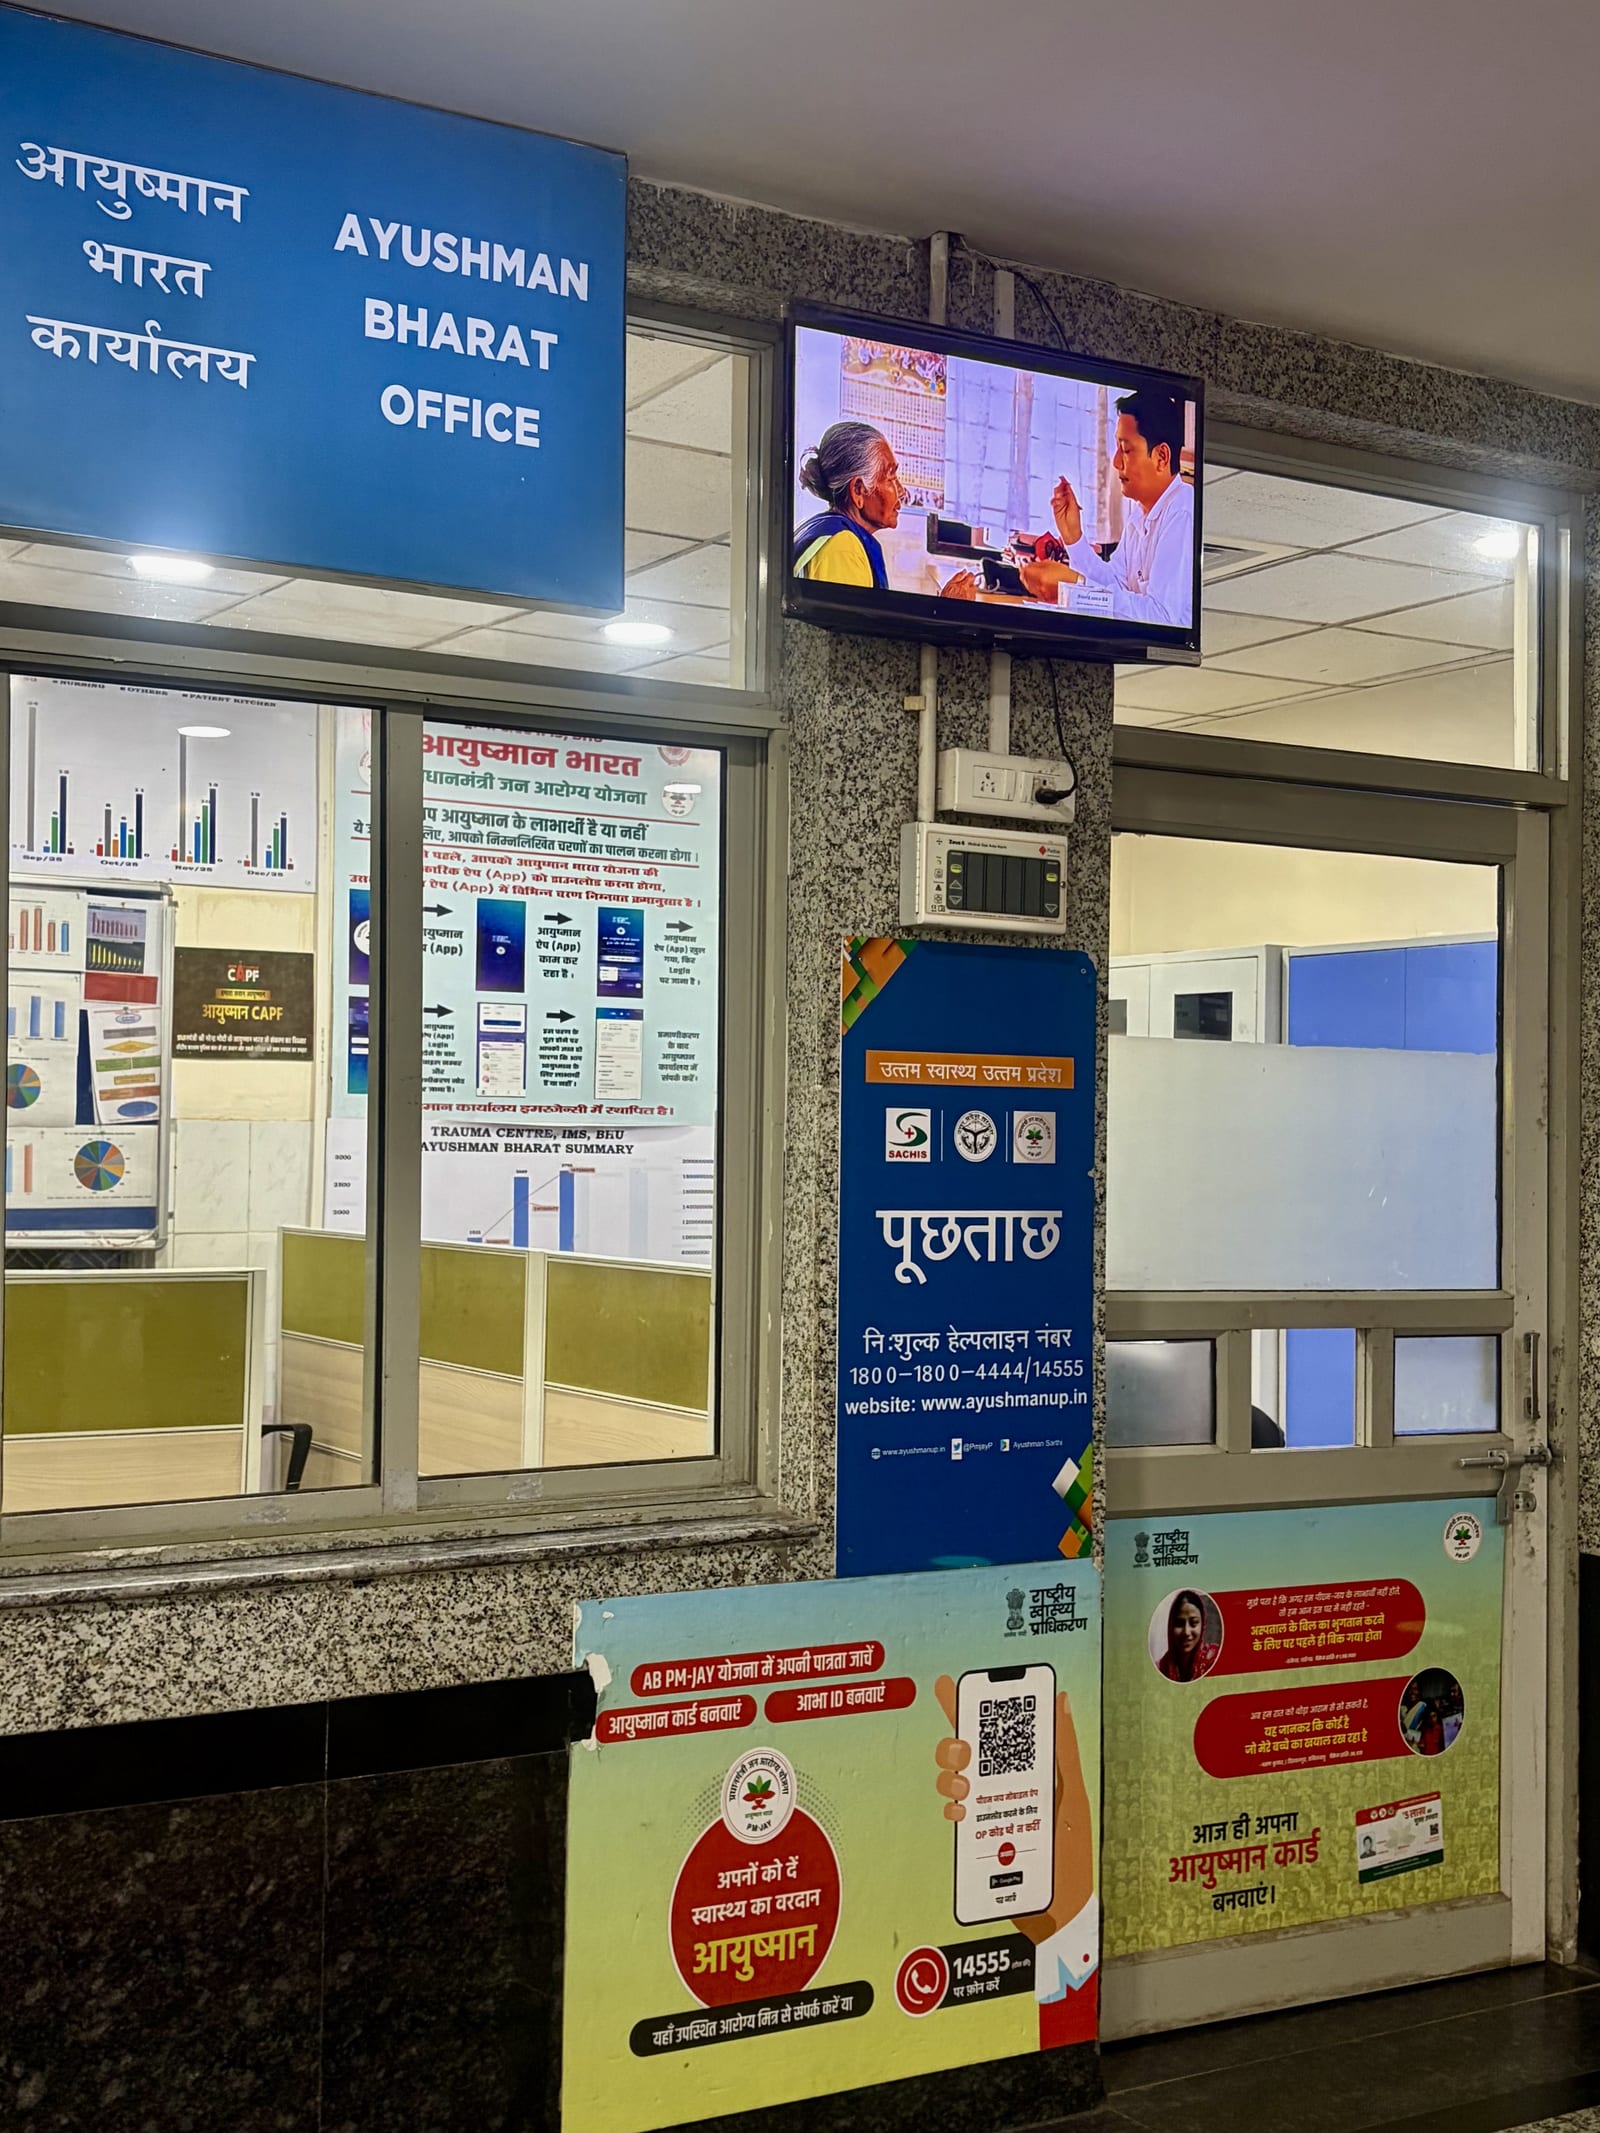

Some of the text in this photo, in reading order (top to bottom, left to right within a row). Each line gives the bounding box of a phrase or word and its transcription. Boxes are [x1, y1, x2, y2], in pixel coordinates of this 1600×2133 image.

[16, 142, 250, 223] आयुष्मान
[334, 213, 589, 301] AYUSHMAN
[83, 239, 212, 298] भारत
[364, 297, 558, 370] BHARAT
[25, 315, 256, 389] कार्यालय
[380, 384, 540, 448] OFFICE
[565, 750, 642, 777] भारत
[498, 777, 530, 793] जन
[534, 780, 590, 799] आरोग्य
[593, 784, 647, 805] योजना
[441, 809, 649, 840] आयुष्मान के लाभार्थी है या नहीं
[448, 830, 484, 844] आपको
[486, 831, 555, 850] निम्नलिखित
[557, 840, 588, 853] चरणों
[589, 843, 603, 854] का
[605, 844, 636, 857] पालन
[638, 849, 667, 860] करना
[486, 869, 527, 881] (App)
[453, 881, 494, 894] (App)
[537, 927, 582, 938] आयुष्मान
[430, 943, 463, 956] (App)
[551, 941, 581, 953] (App)
[538, 954, 578, 965] काम कर
[228, 966, 260, 982] CAPF
[202, 1004, 284, 1024] आयुष्मान CAPF
[879, 1062, 1063, 1083] उत्तम स्वास्थ्य उत्तम प्रदेश
[456, 1101, 603, 1114] कार्यालय में
[431, 1126, 624, 1141] TRAUMA CENTRE, IMS, BHU
[422, 1141, 635, 1155] AYUSHMAN BHARAT SUMMARY
[888, 1149, 927, 1159] SACHIS
[875, 1210, 1063, 1284] पूछताछ
[947, 1325, 1029, 1353] हेल्पलाइन
[1035, 1323, 1072, 1349] नंबर
[845, 1389, 1088, 1415] website: www.ayushmanup.in
[1152, 1528, 1190, 1544] राष्ट्रीय
[1152, 1543, 1189, 1555] स्वास्थ्य
[1152, 1553, 1199, 1567] प्राधिकरण
[1029, 1583, 1076, 1603] राष्ट्रीय
[1029, 1602, 1076, 1619] स्वास्थ्य
[1028, 1617, 1088, 1636] प्राधिकरण
[1251, 1624, 1287, 1636] अस्पताल
[1289, 1620, 1298, 1632] के
[1318, 1620, 1330, 1630] का
[1253, 1638, 1262, 1651] के
[1263, 1637, 1281, 1650] लिए
[1296, 1634, 1316, 1648] पहले
[642, 1671, 662, 1690] AB
[665, 1665, 715, 1688] PM-JAY
[718, 1659, 758, 1681] योजना
[761, 1654, 773, 1677] में
[776, 1650, 810, 1675] अपनी
[813, 1650, 847, 1672] पात्रता
[796, 1682, 886, 1712] आभा ID बनवाएं
[608, 1699, 743, 1738] आयुष्मान कार्ड बनवाएं
[1264, 1726, 1277, 1737] यह
[1279, 1722, 1311, 1735] जानकर
[1312, 1718, 1325, 1731] कि
[1244, 1741, 1257, 1754] जो
[1290, 1739, 1303, 1749] का
[1193, 1812, 1299, 1844] आज ही अपना
[1168, 1827, 1321, 1890] आयुष्मान कार्ड
[717, 1855, 799, 1889] अपनों को दें
[691, 1889, 821, 1925] स्वास्थ्य का वरदान
[692, 1924, 818, 1982] आयुष्मान
[953, 1948, 1010, 1979] 14555
[953, 1986, 965, 1998] पर
[986, 1976, 1000, 1991] करें
[652, 1995, 853, 2046] यहाँ उपस्थित आरोग्य मित्र से संपर्क करें या
